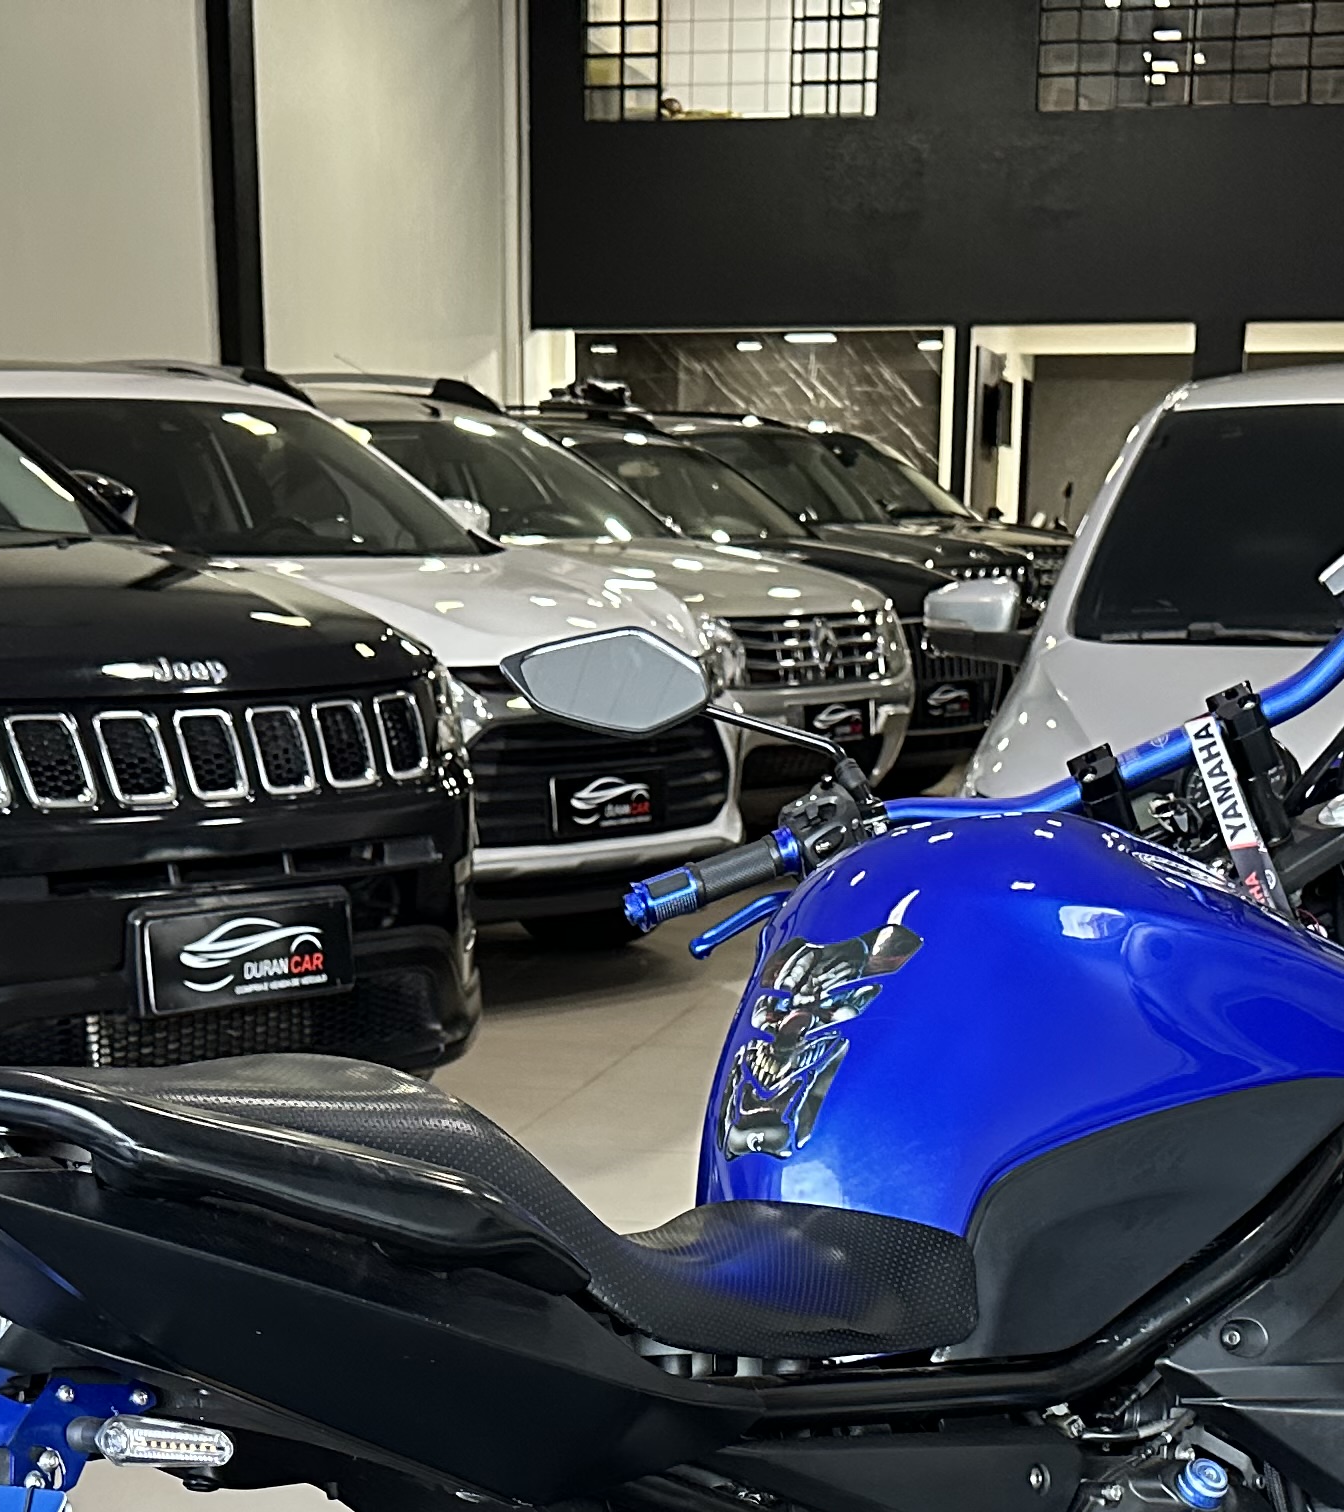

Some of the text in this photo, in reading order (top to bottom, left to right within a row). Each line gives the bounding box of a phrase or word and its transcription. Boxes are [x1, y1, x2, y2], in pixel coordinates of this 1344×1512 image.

[154, 655, 229, 684] Jeep
[1193, 722, 1247, 842] YAMAHA
[243, 952, 325, 980] DURAN CAR
